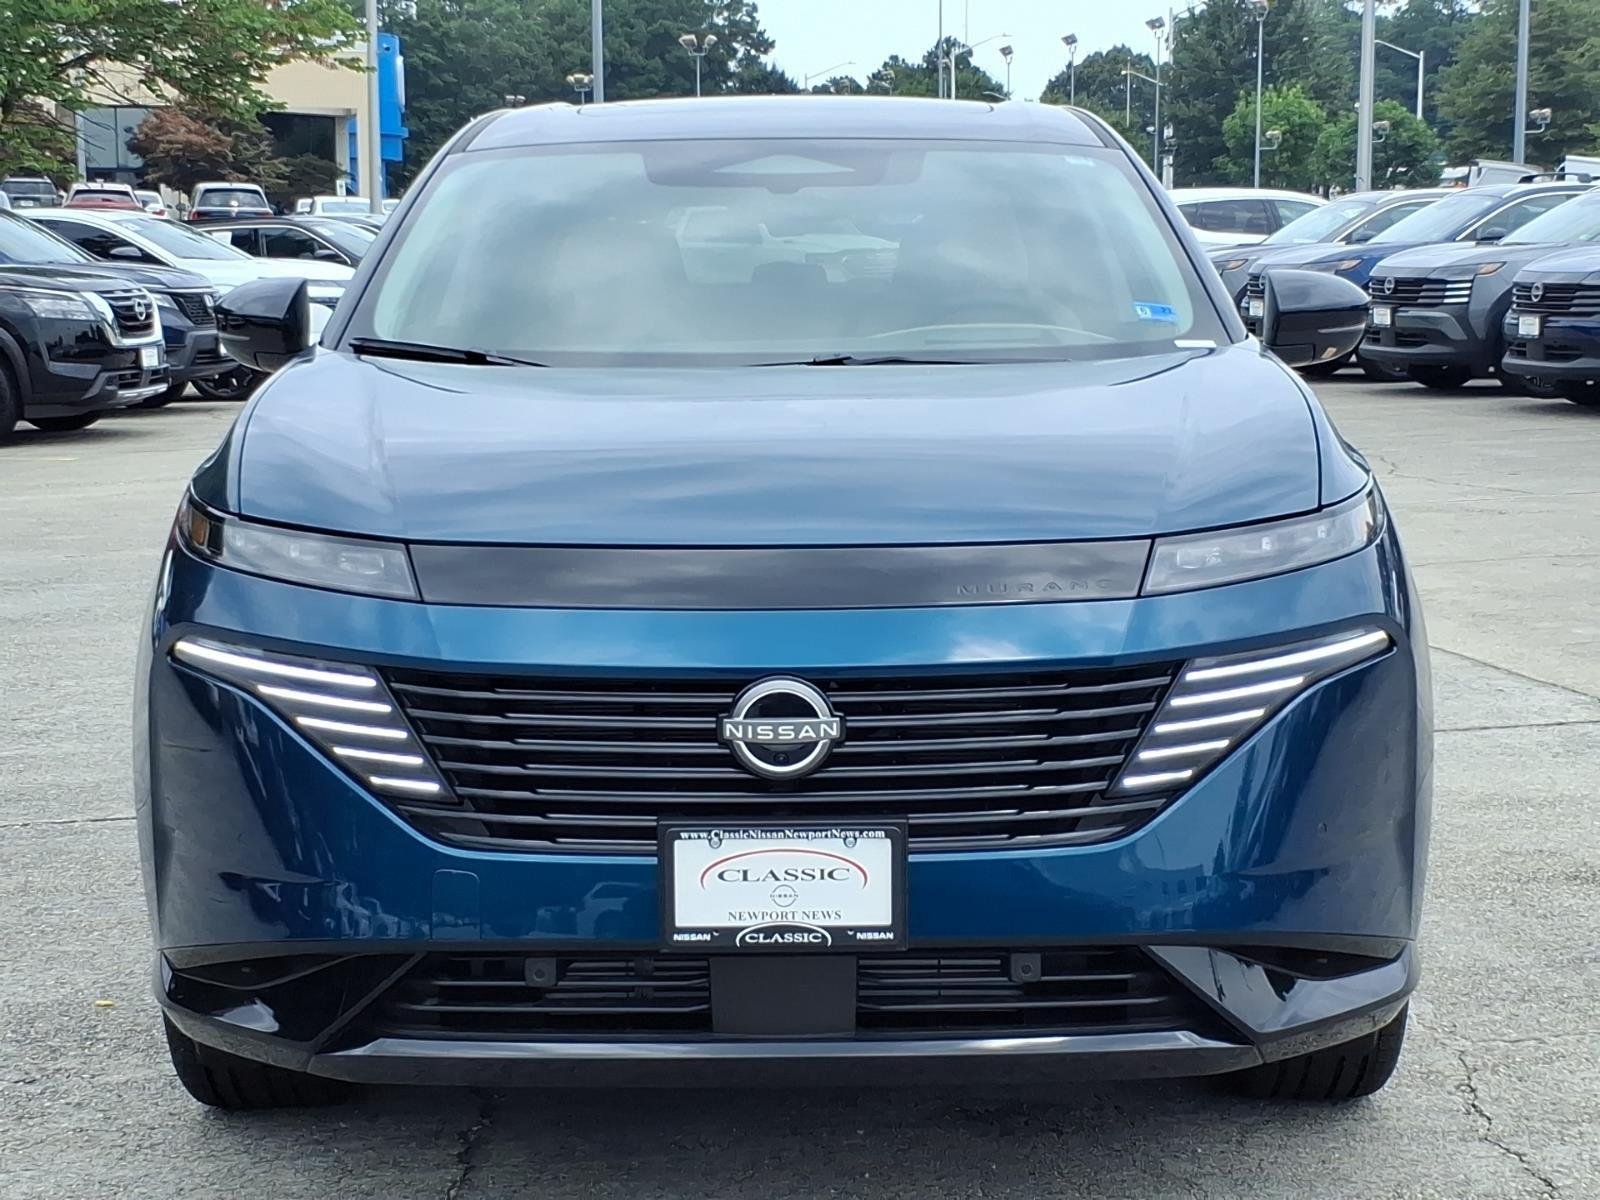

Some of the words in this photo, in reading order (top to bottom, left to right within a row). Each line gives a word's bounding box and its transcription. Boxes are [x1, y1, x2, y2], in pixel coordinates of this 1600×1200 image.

[725, 722, 837, 740] NISSAN
[680, 829, 886, 841] www.ClassicNissanNewportNews.com
[717, 867, 850, 882] CLASSIC
[728, 911, 798, 922] NEWPORT
[801, 910, 842, 920] NEWS
[673, 933, 711, 941] NISSAN
[745, 932, 822, 943] CLASSIC
[856, 931, 894, 940] NISSAN
